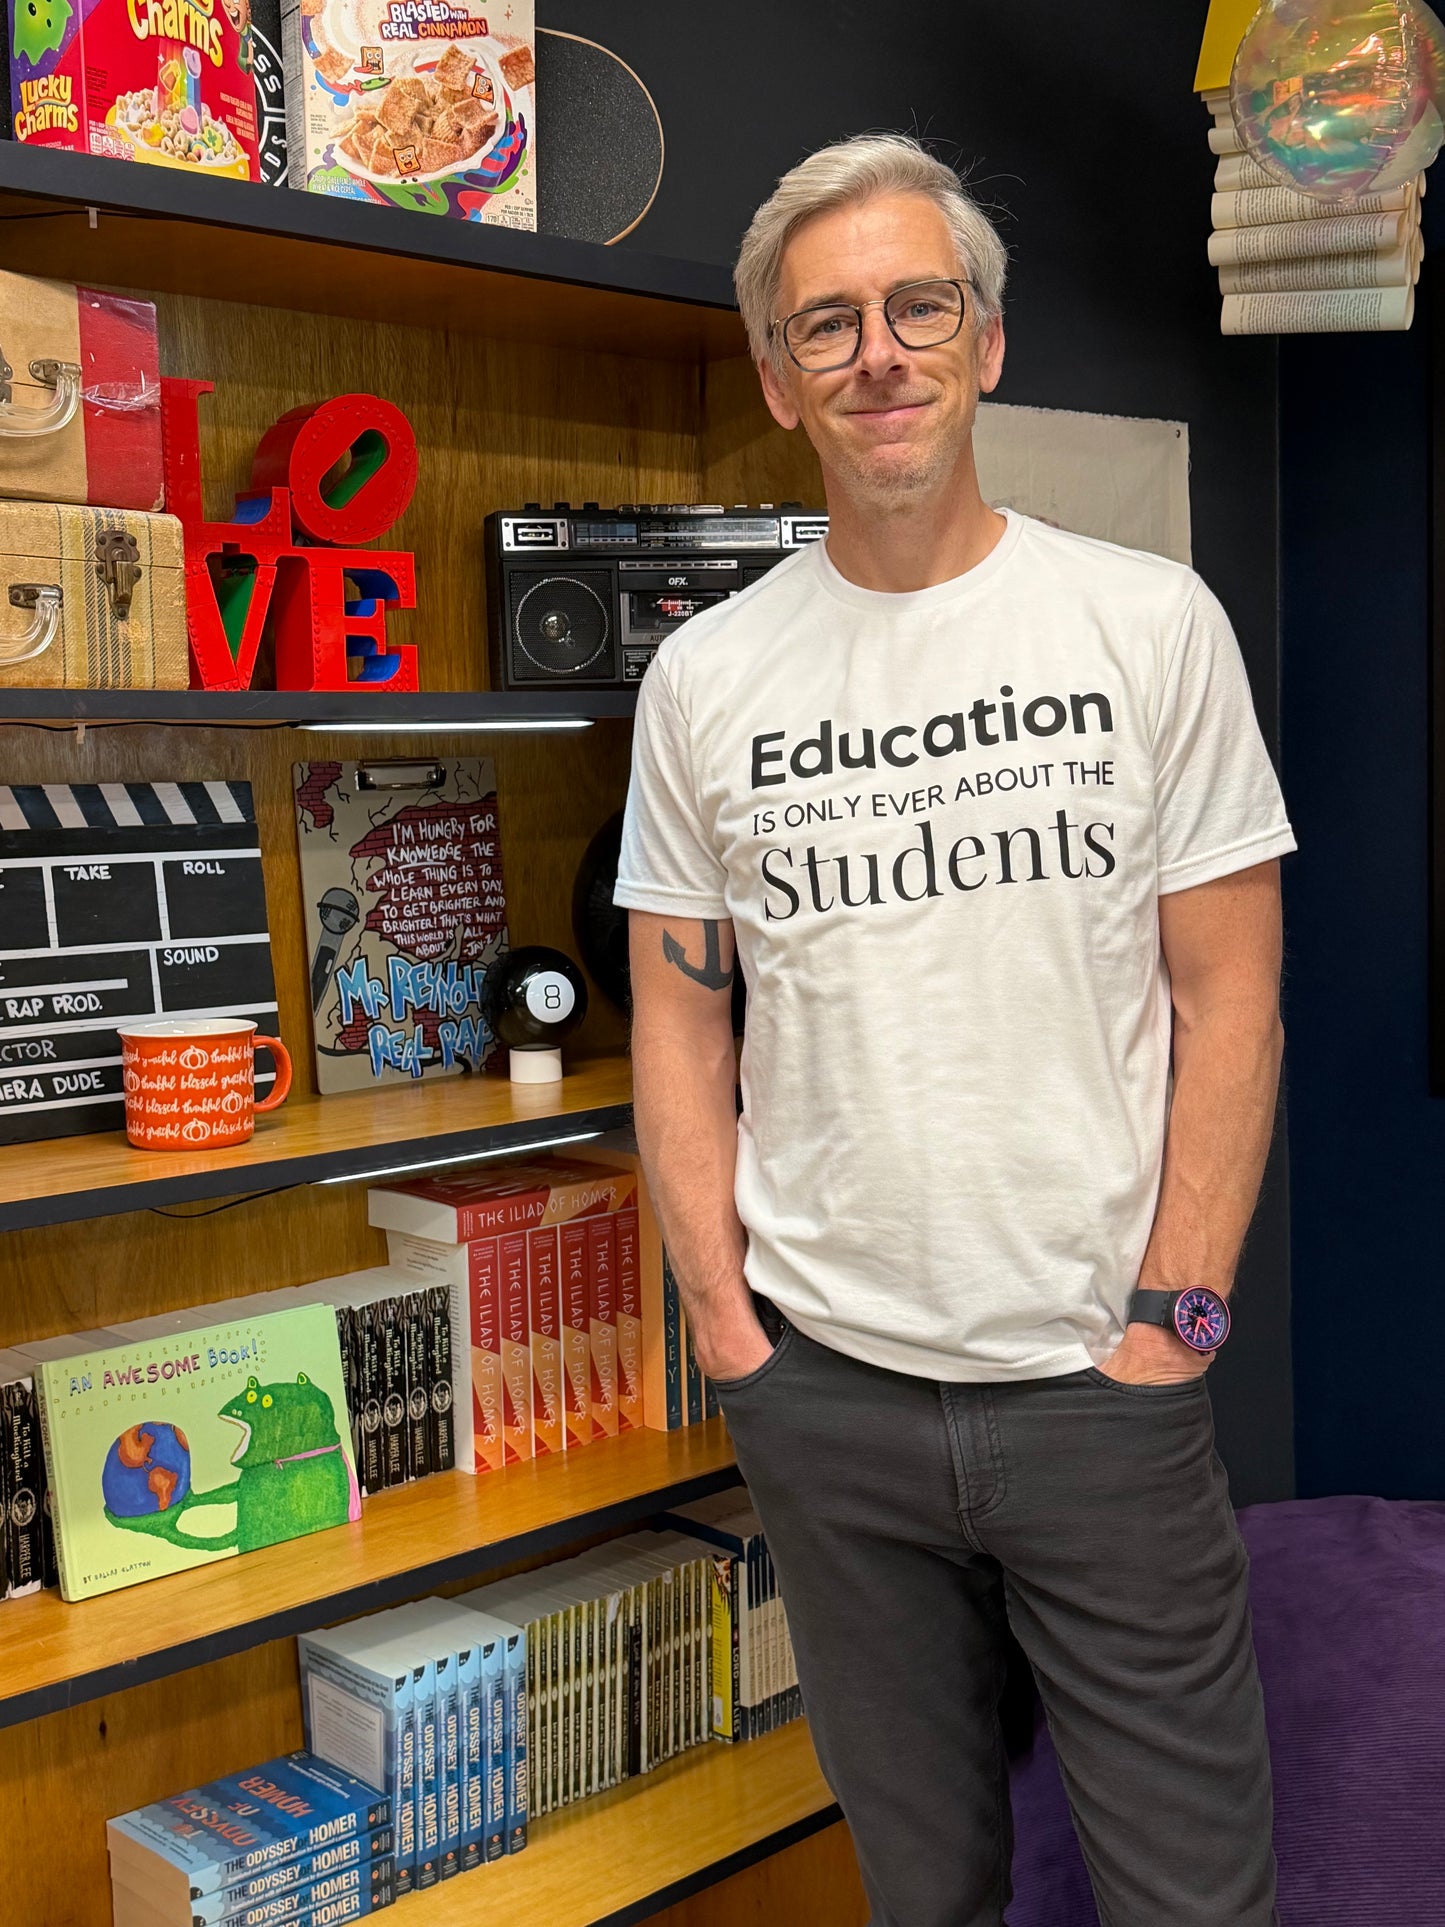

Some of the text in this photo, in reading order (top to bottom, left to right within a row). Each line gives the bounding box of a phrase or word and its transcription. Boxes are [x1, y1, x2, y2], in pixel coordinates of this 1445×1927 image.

[382, 20, 487, 38] REAL CINNAMON
[390, 0, 467, 22] BLASTED WITH
[128, 0, 222, 68] Charms
[20, 74, 72, 113] Lucky
[14, 103, 79, 142] Charms
[752, 685, 1114, 790] Education
[753, 760, 1114, 836] IS ONLY EVER ABOUT THE
[392, 813, 496, 845] I'M HUNGRY FOR
[64, 865, 112, 881] TAKE
[183, 861, 226, 875] ROLL
[373, 863, 492, 888] WHOLE THING IS TO
[386, 841, 495, 866] KNOWLEDGE, THE
[761, 809, 1116, 922] Students
[380, 896, 506, 920] TO GET BRIGHTER AND
[391, 880, 504, 902] LEARN EVERY DAY,
[382, 912, 502, 934] BRIGHTER! THAT'S WHAT
[394, 926, 484, 946] THIS WORLD IS ALL
[163, 948, 219, 966] SOUND
[6, 992, 103, 1018] RAP PROD.
[336, 958, 390, 1025] MR
[544, 984, 560, 1009] 8
[368, 1016, 495, 1080] REAL RAP
[0, 1071, 105, 1101] ERA DUDE
[180, 1072, 218, 1090] blessed
[146, 1098, 180, 1114] blessed
[182, 1097, 221, 1114] thankful
[212, 1118, 242, 1135] blessed
[478, 1208, 505, 1228] THE
[510, 1204, 545, 1222] ILIAD
[550, 1195, 566, 1214] OF
[572, 1185, 617, 1208] HOMER
[478, 1265, 492, 1299] THE
[508, 1258, 522, 1292] THE
[538, 1253, 552, 1286] THE
[570, 1248, 582, 1280] THE
[480, 1304, 493, 1349] ILIAD
[510, 1296, 522, 1342] ILIAD
[540, 1290, 553, 1335] ILIAD
[570, 1284, 584, 1329] ILIAD
[596, 1240, 613, 1412] THE ILIAD OF HOMER
[620, 1234, 638, 1404] THE ILIAD OF HOMER
[432, 1316, 442, 1374] Mockingbird
[442, 1324, 448, 1336] To
[541, 1341, 554, 1361] OF
[572, 1335, 584, 1354] OF
[69, 1338, 258, 1396] AN AWESOME BOOK!
[481, 1355, 494, 1376] OF
[510, 1347, 524, 1368] OF
[482, 1383, 496, 1444] HOMER
[512, 1375, 525, 1436] HOMER
[542, 1369, 556, 1429] HOMER
[572, 1362, 586, 1422] HOMER
[12, 1414, 24, 1482] Mockingbird
[23, 1422, 31, 1435] To
[23, 1437, 32, 1460] Kill
[18, 1533, 32, 1578] HARPER LEE
[83, 1574, 92, 1584] BY
[469, 1707, 480, 1764] ODYSSEY
[492, 1698, 504, 1754] ODYSSEY
[516, 1692, 526, 1748] ODYSSEY
[402, 1732, 414, 1789] ODYSSEY
[424, 1724, 435, 1782] ODYSSEY
[446, 1714, 457, 1772] ODYSSEY
[468, 1774, 482, 1831] HOMER
[492, 1766, 504, 1822] HOMER
[515, 1760, 526, 1814] HOMER
[401, 1800, 414, 1856] HOMER
[423, 1792, 438, 1849] HOMER
[446, 1782, 458, 1839] HOMER
[224, 1812, 357, 1874] THE ODYSSEY HOMER
[228, 1840, 360, 1902] THE ODYSSEY HOMER
[246, 1869, 360, 1925] ODYSSEY HOMER
[312, 1894, 360, 1926] HOMER
